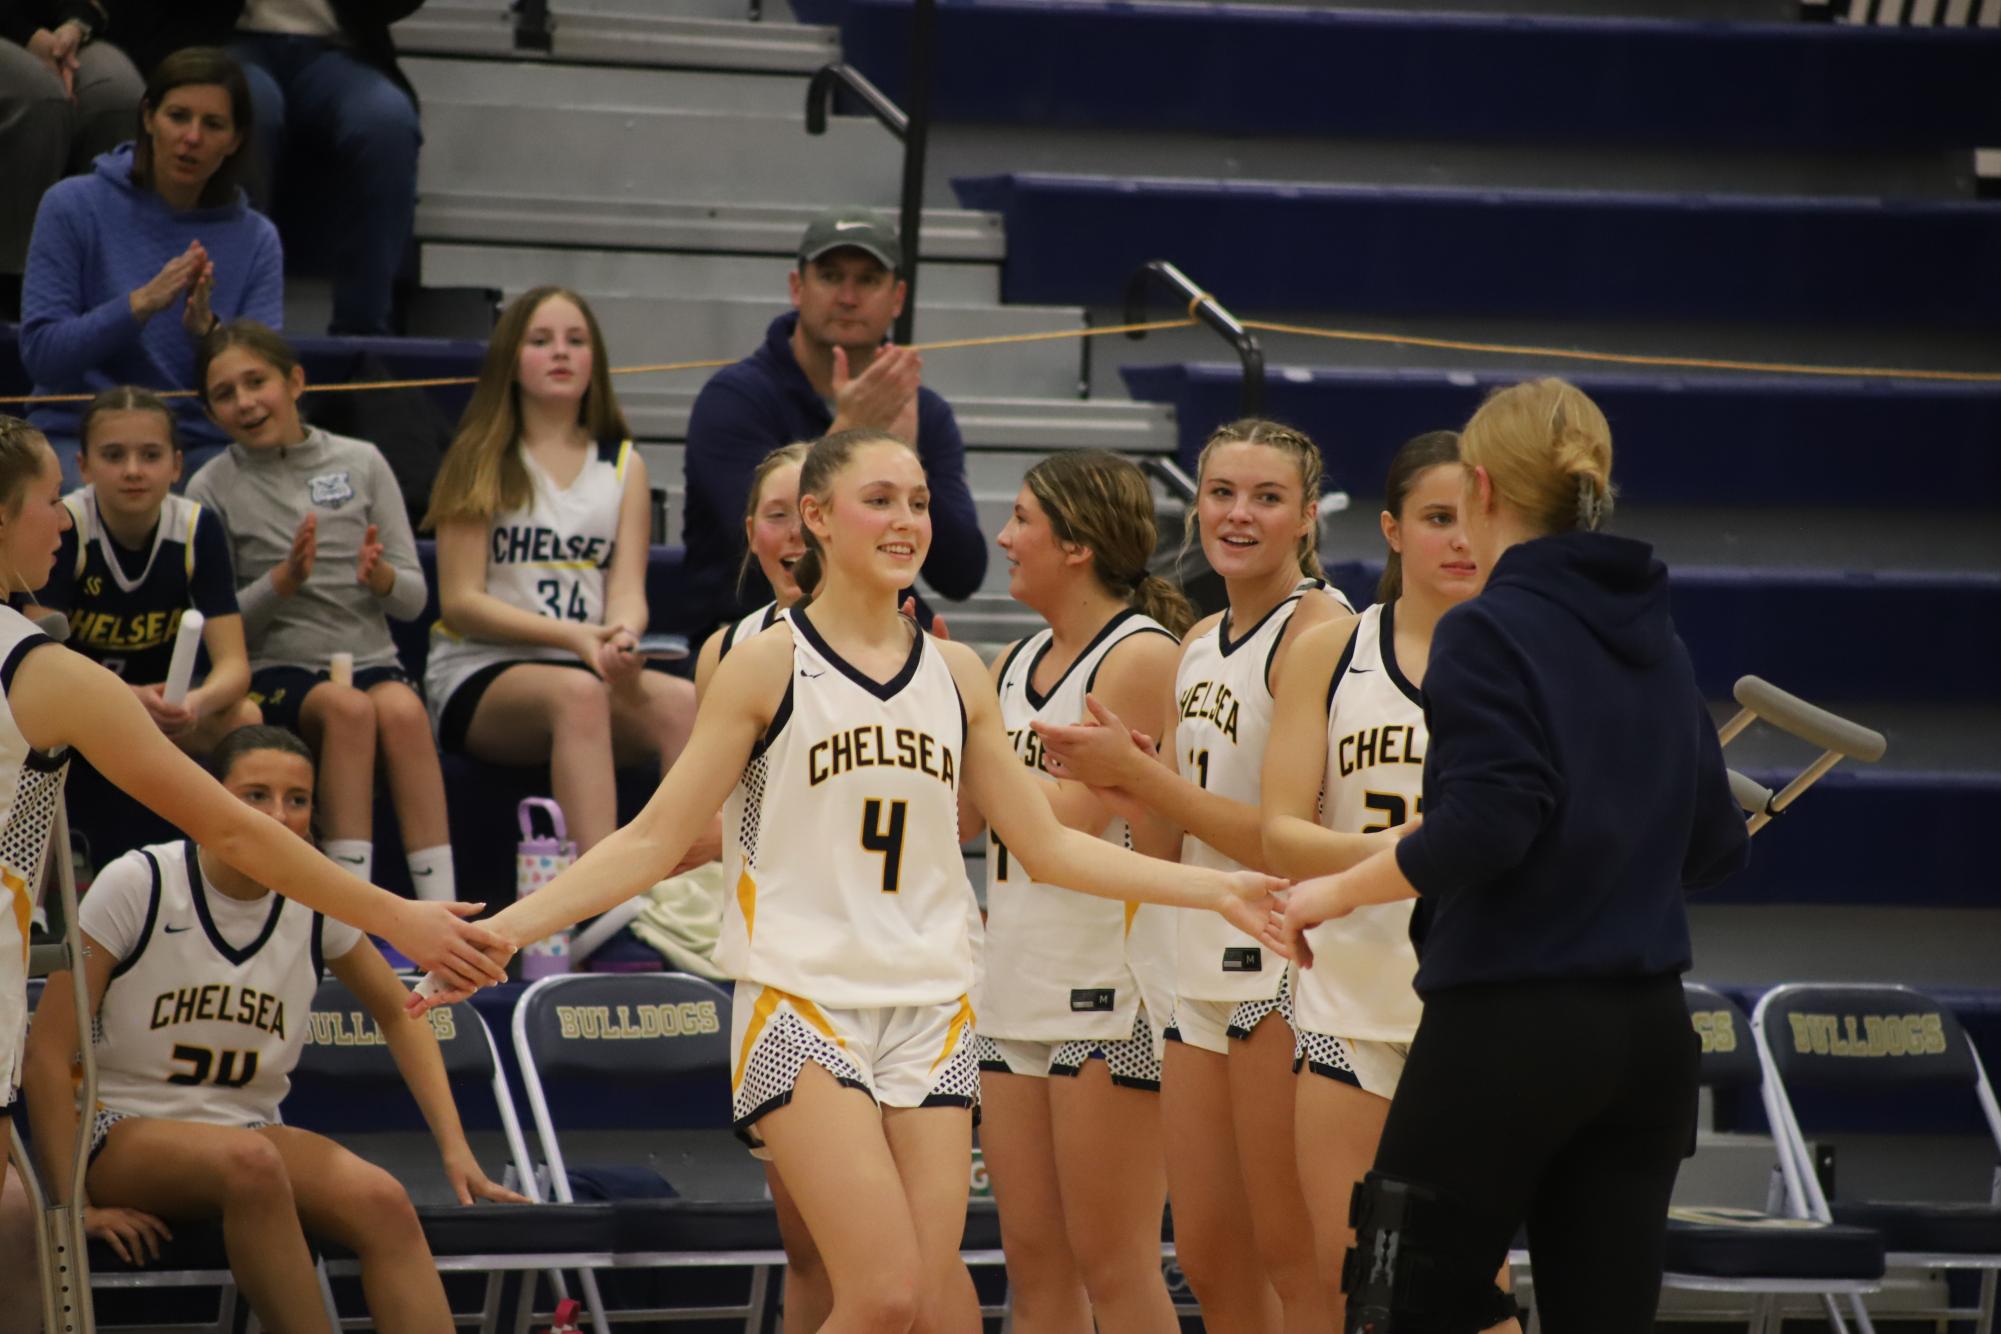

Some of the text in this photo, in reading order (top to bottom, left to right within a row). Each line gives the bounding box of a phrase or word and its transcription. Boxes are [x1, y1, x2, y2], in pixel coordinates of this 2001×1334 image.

[537, 579, 588, 622] 34
[69, 607, 183, 645] HELSEA
[1178, 680, 1240, 745] HELSEA
[808, 724, 955, 792] CHELSEA
[1338, 723, 1424, 779] CHEL
[1361, 789, 1424, 834] 2
[860, 796, 909, 895] 4
[1245, 954, 1255, 965] M
[149, 983, 286, 1042] CHELSEA
[556, 1000, 720, 1040] BULLDOGS
[1099, 994, 1109, 1005] M
[303, 1006, 457, 1046] ULLS
[1788, 1011, 1946, 1058] BULLDOGS
